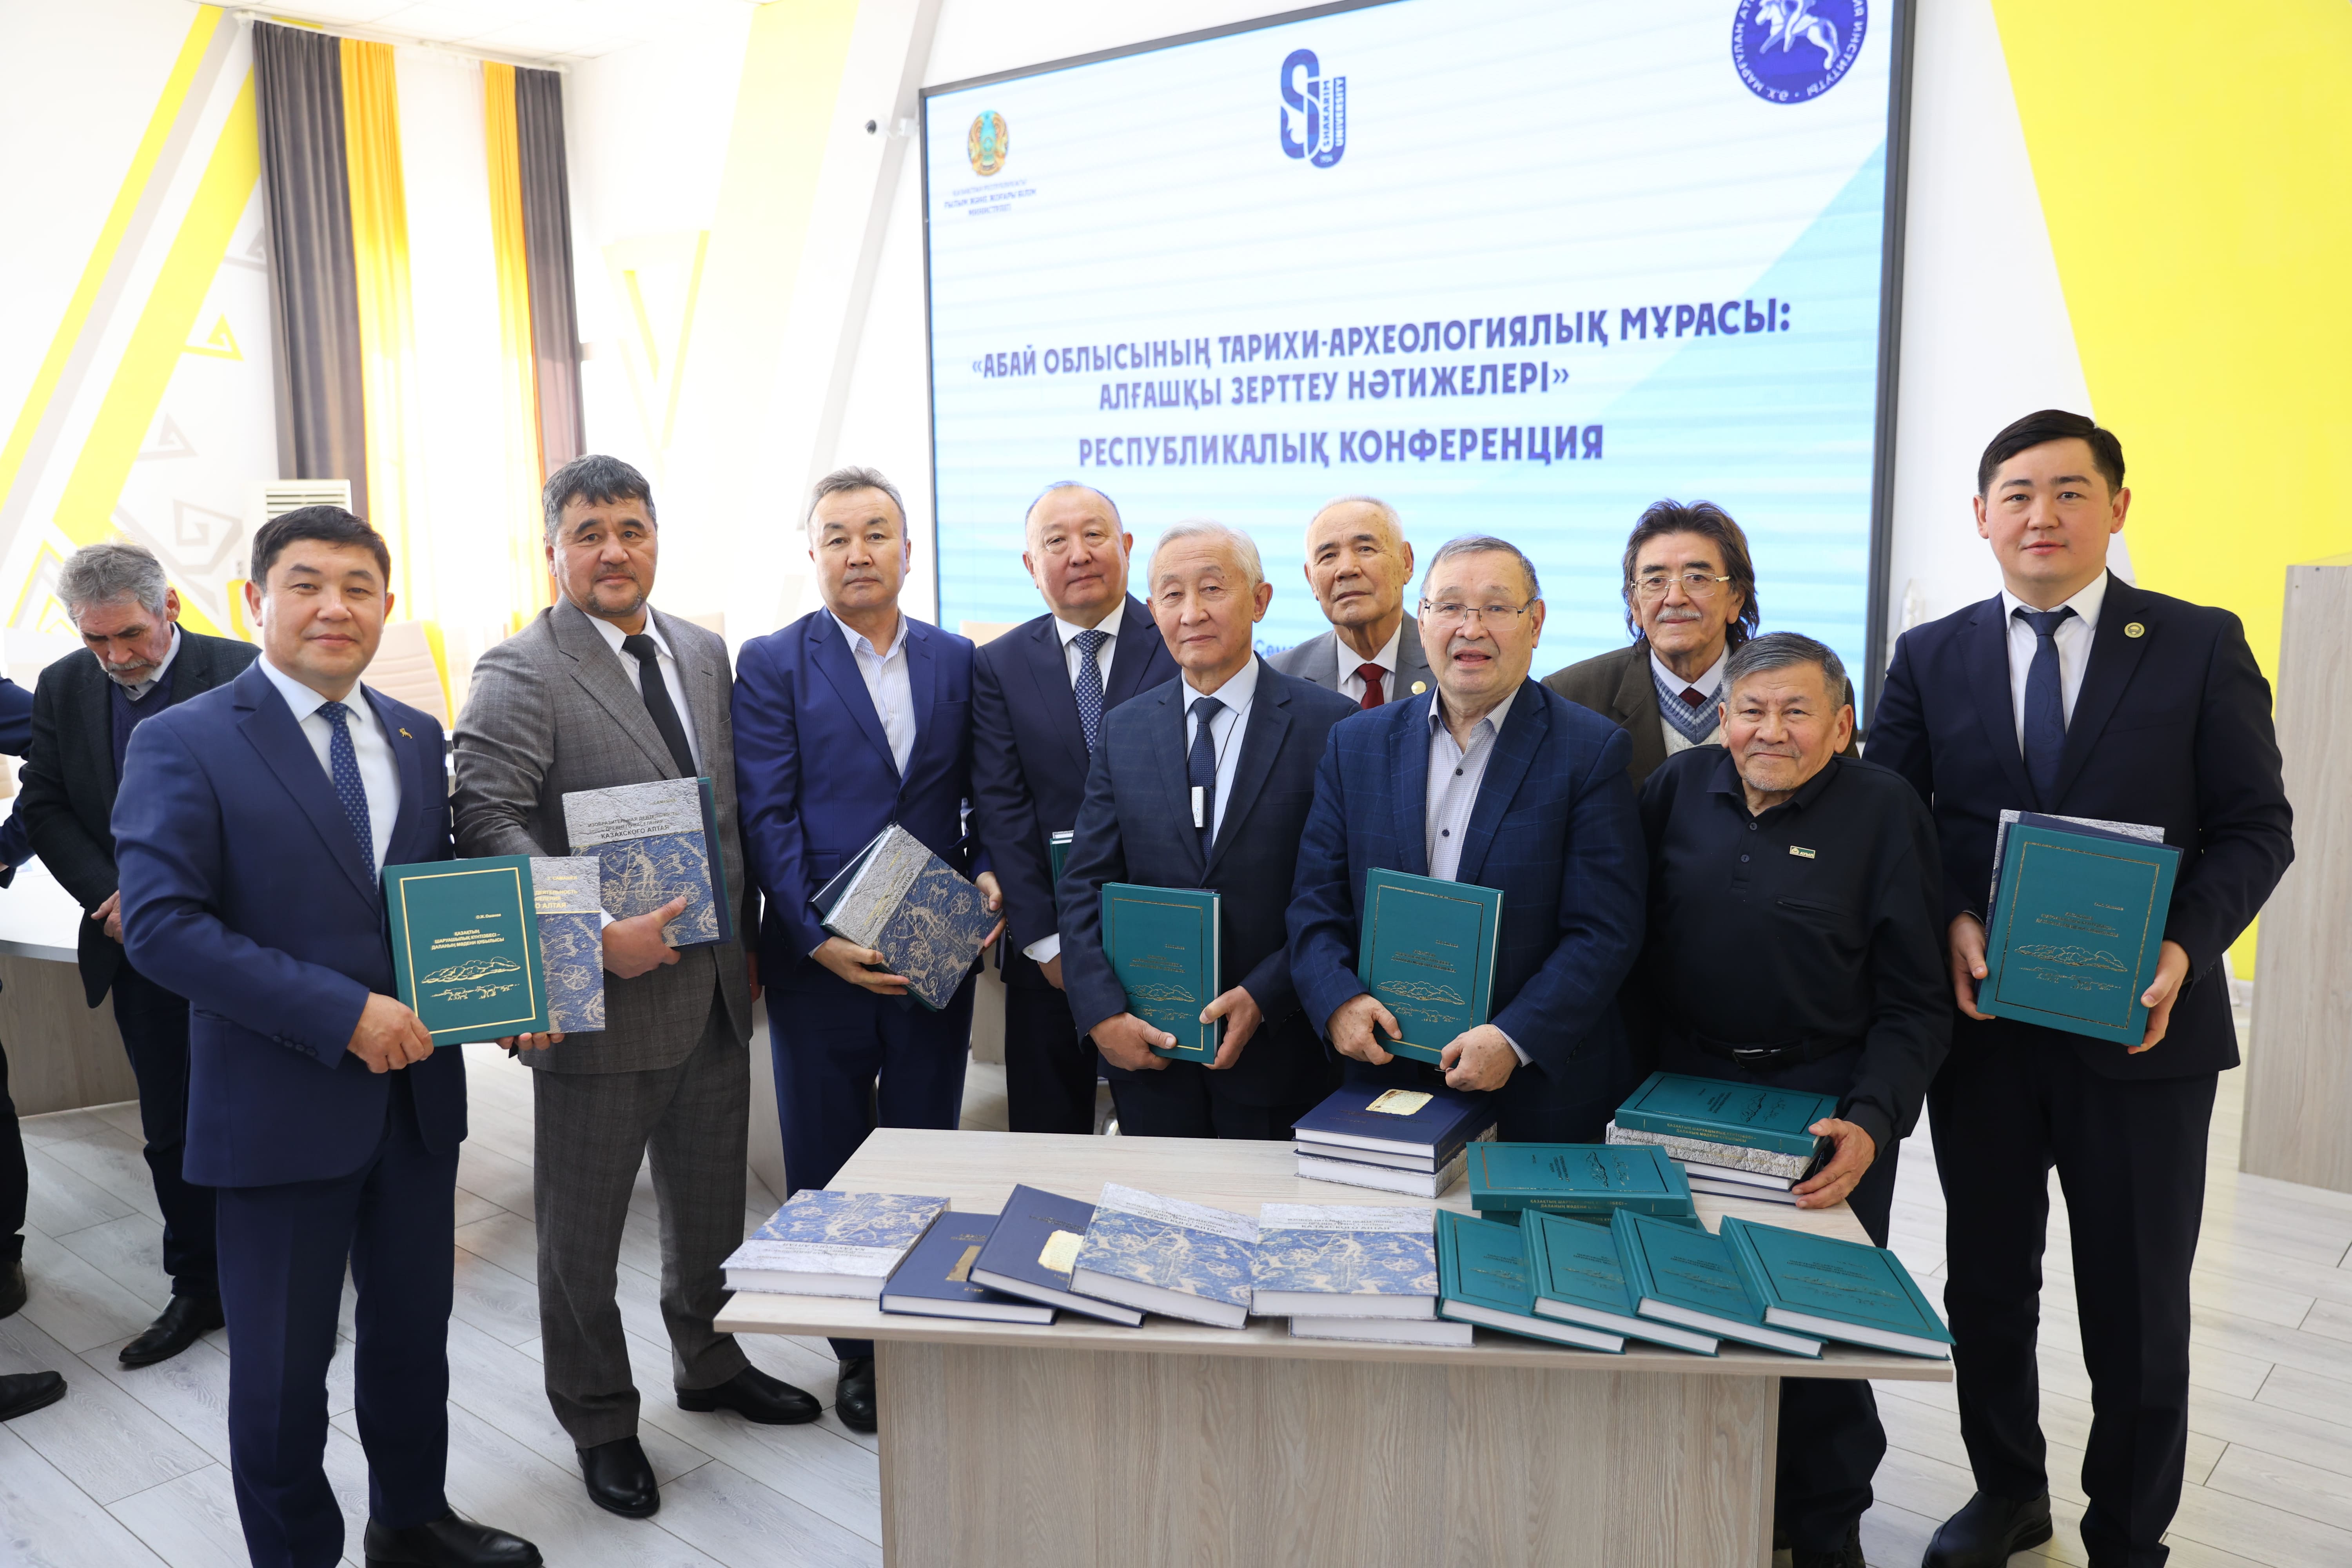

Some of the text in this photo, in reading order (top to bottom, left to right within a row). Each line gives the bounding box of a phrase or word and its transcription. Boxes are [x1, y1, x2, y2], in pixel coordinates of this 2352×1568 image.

[1806, 21, 1863, 96] ИНСТИТУТЫ
[1334, 78, 1345, 147] UNIVERSITY
[973, 298, 1790, 378] «АБАЙ ОБЛЫСЫНЫҢ ТАРИХИ-АРХЕОЛОГИЯЛЫҚ МҰРАСЫ:
[1100, 361, 1569, 410] АЛҒАШҚЫ ЗЕРТТЕУ НӘТИЖЕЛЕРІ»
[1079, 424, 1603, 468] РЕСПУБЛИКАЛЫҚ КОНФЕРЕНЦИЯ
[588, 812, 680, 828] ИЗОБРАЗИТЕЛЬНАЯ ДЕЯТЕЛЬНОСТЬ
[601, 828, 646, 839] КАЗАХСКОГО
[901, 871, 915, 891] АЛТАЯ
[431, 942, 456, 950] ДАЛАНЫҢ
[1615, 1134, 1657, 1145] ИЗОБРАЗИТЕЛЬНАЯ
[1138, 1211, 1222, 1233] КАЗАХСКОГО АЛТАЯ
